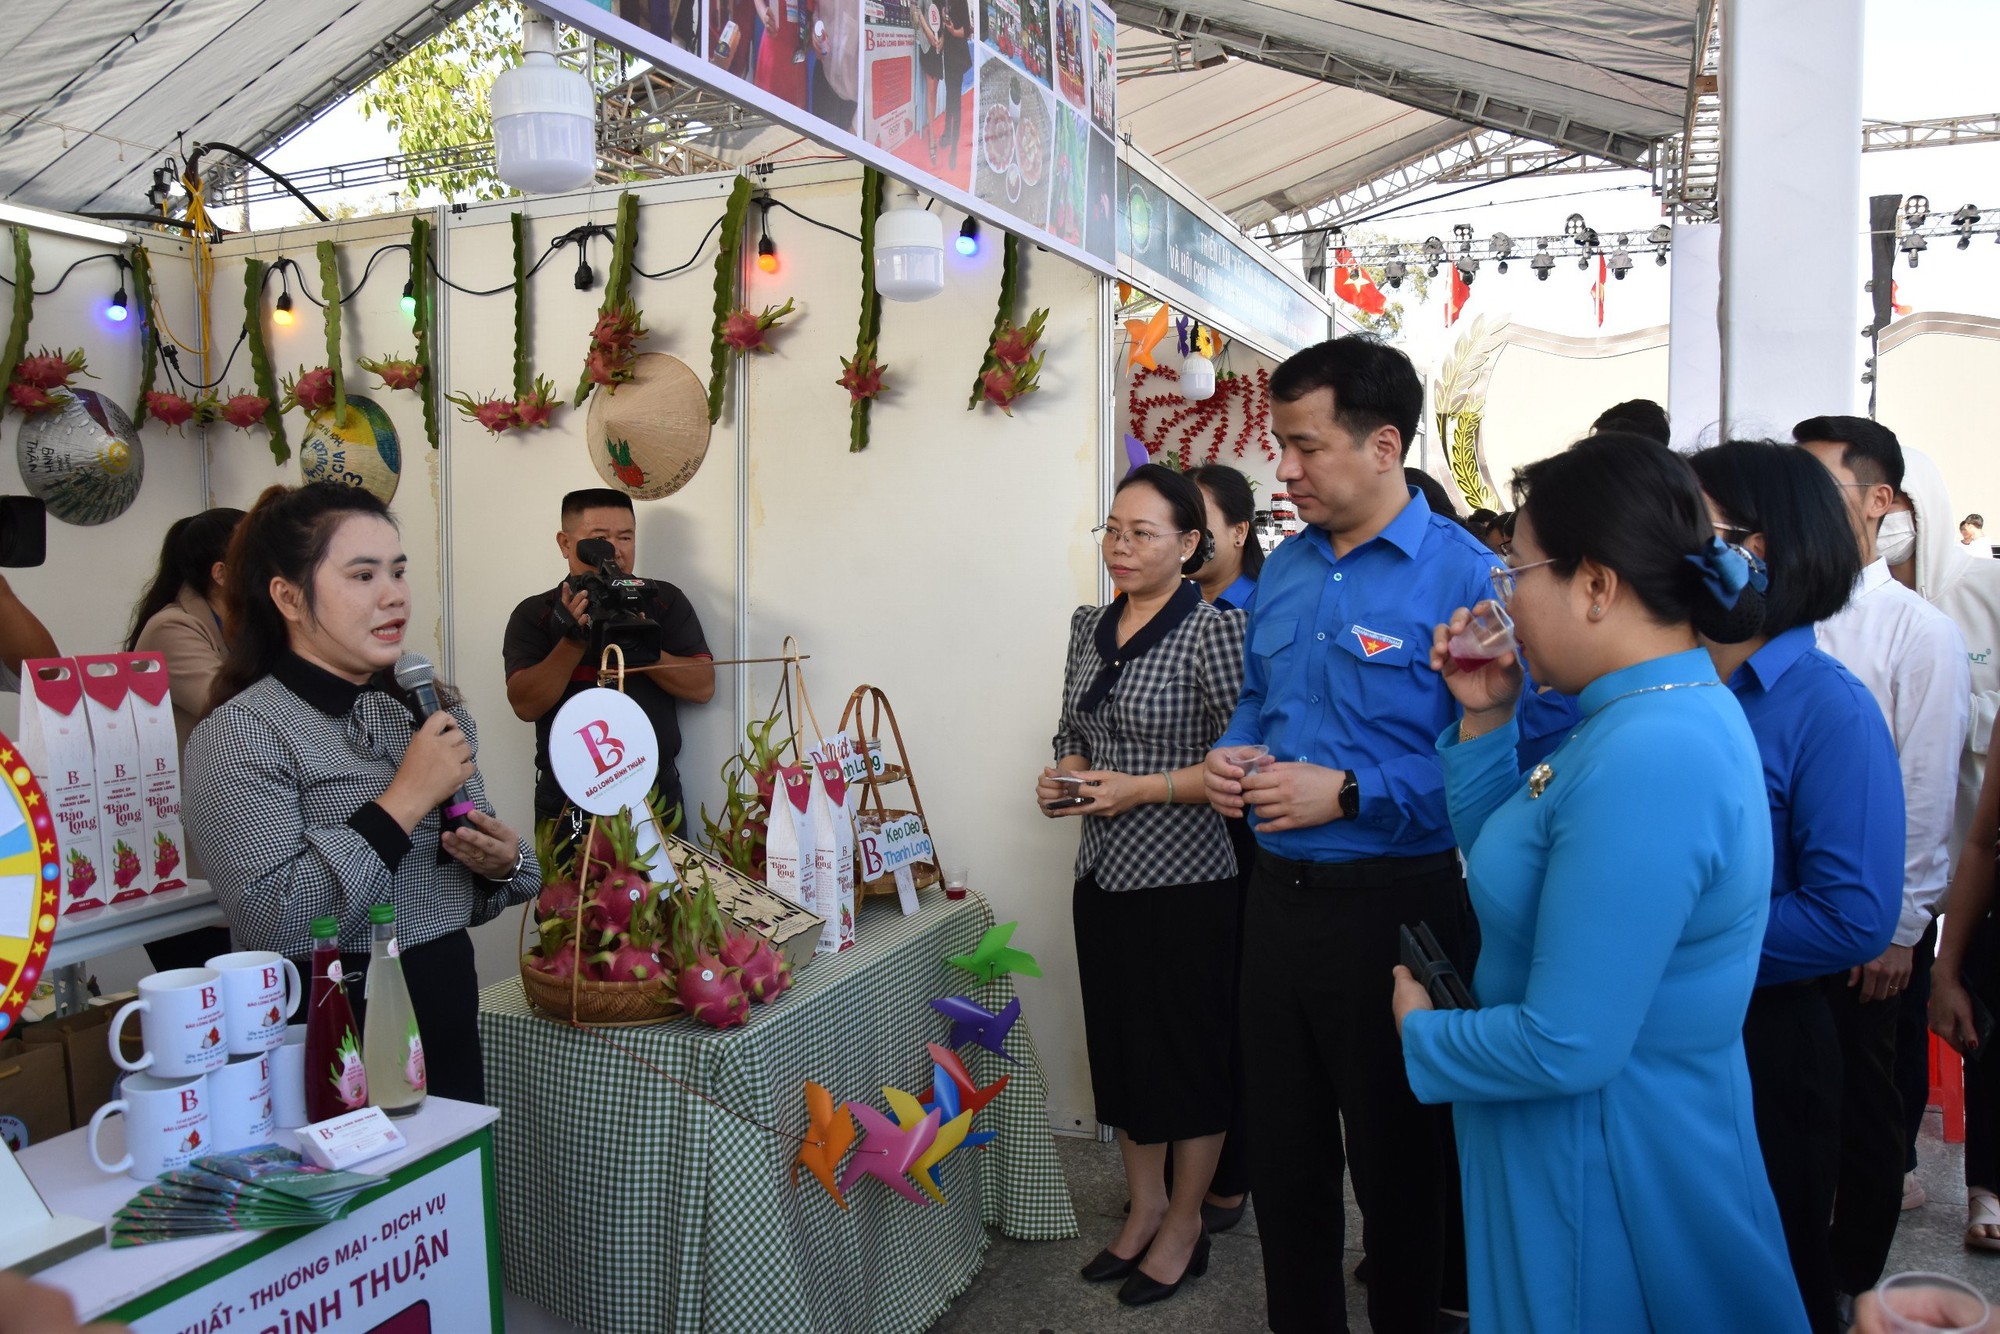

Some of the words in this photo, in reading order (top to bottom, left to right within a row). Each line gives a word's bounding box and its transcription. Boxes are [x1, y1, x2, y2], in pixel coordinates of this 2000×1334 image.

[1169, 243, 1179, 271] VÀ
[1181, 250, 1193, 283] HỘI
[332, 451, 346, 473] GIA
[573, 720, 625, 778] B
[115, 764, 126, 778] B
[156, 758, 166, 771] B
[854, 756, 881, 774] Log
[68, 770, 79, 785] B
[585, 786, 598, 797] BẢO
[598, 776, 615, 790] LONG
[614, 768, 628, 780] BÌNH
[627, 756, 646, 771] THUẬN
[104, 800, 129, 815] Bảo
[146, 793, 169, 807] Bảo
[56, 808, 83, 823] Bảo
[116, 809, 142, 827] Long
[156, 801, 180, 819] Long
[68, 816, 97, 835] Long
[885, 828, 903, 843] Kẹo
[904, 819, 920, 836] Dẻo
[859, 837, 883, 876] B
[884, 845, 911, 866] Thanh
[910, 839, 931, 856] Long
[770, 860, 787, 869] Bảo
[777, 868, 795, 878] Long
[261, 967, 278, 989] B
[200, 987, 217, 1009] B
[179, 1089, 199, 1112] B
[319, 1128, 334, 1140] B
[250, 1257, 330, 1310] THƯƠNG
[335, 1235, 368, 1266] MẠI
[381, 1207, 422, 1241] DỊCH
[426, 1193, 447, 1216] VỤ
[350, 1229, 450, 1308] THUẬN
